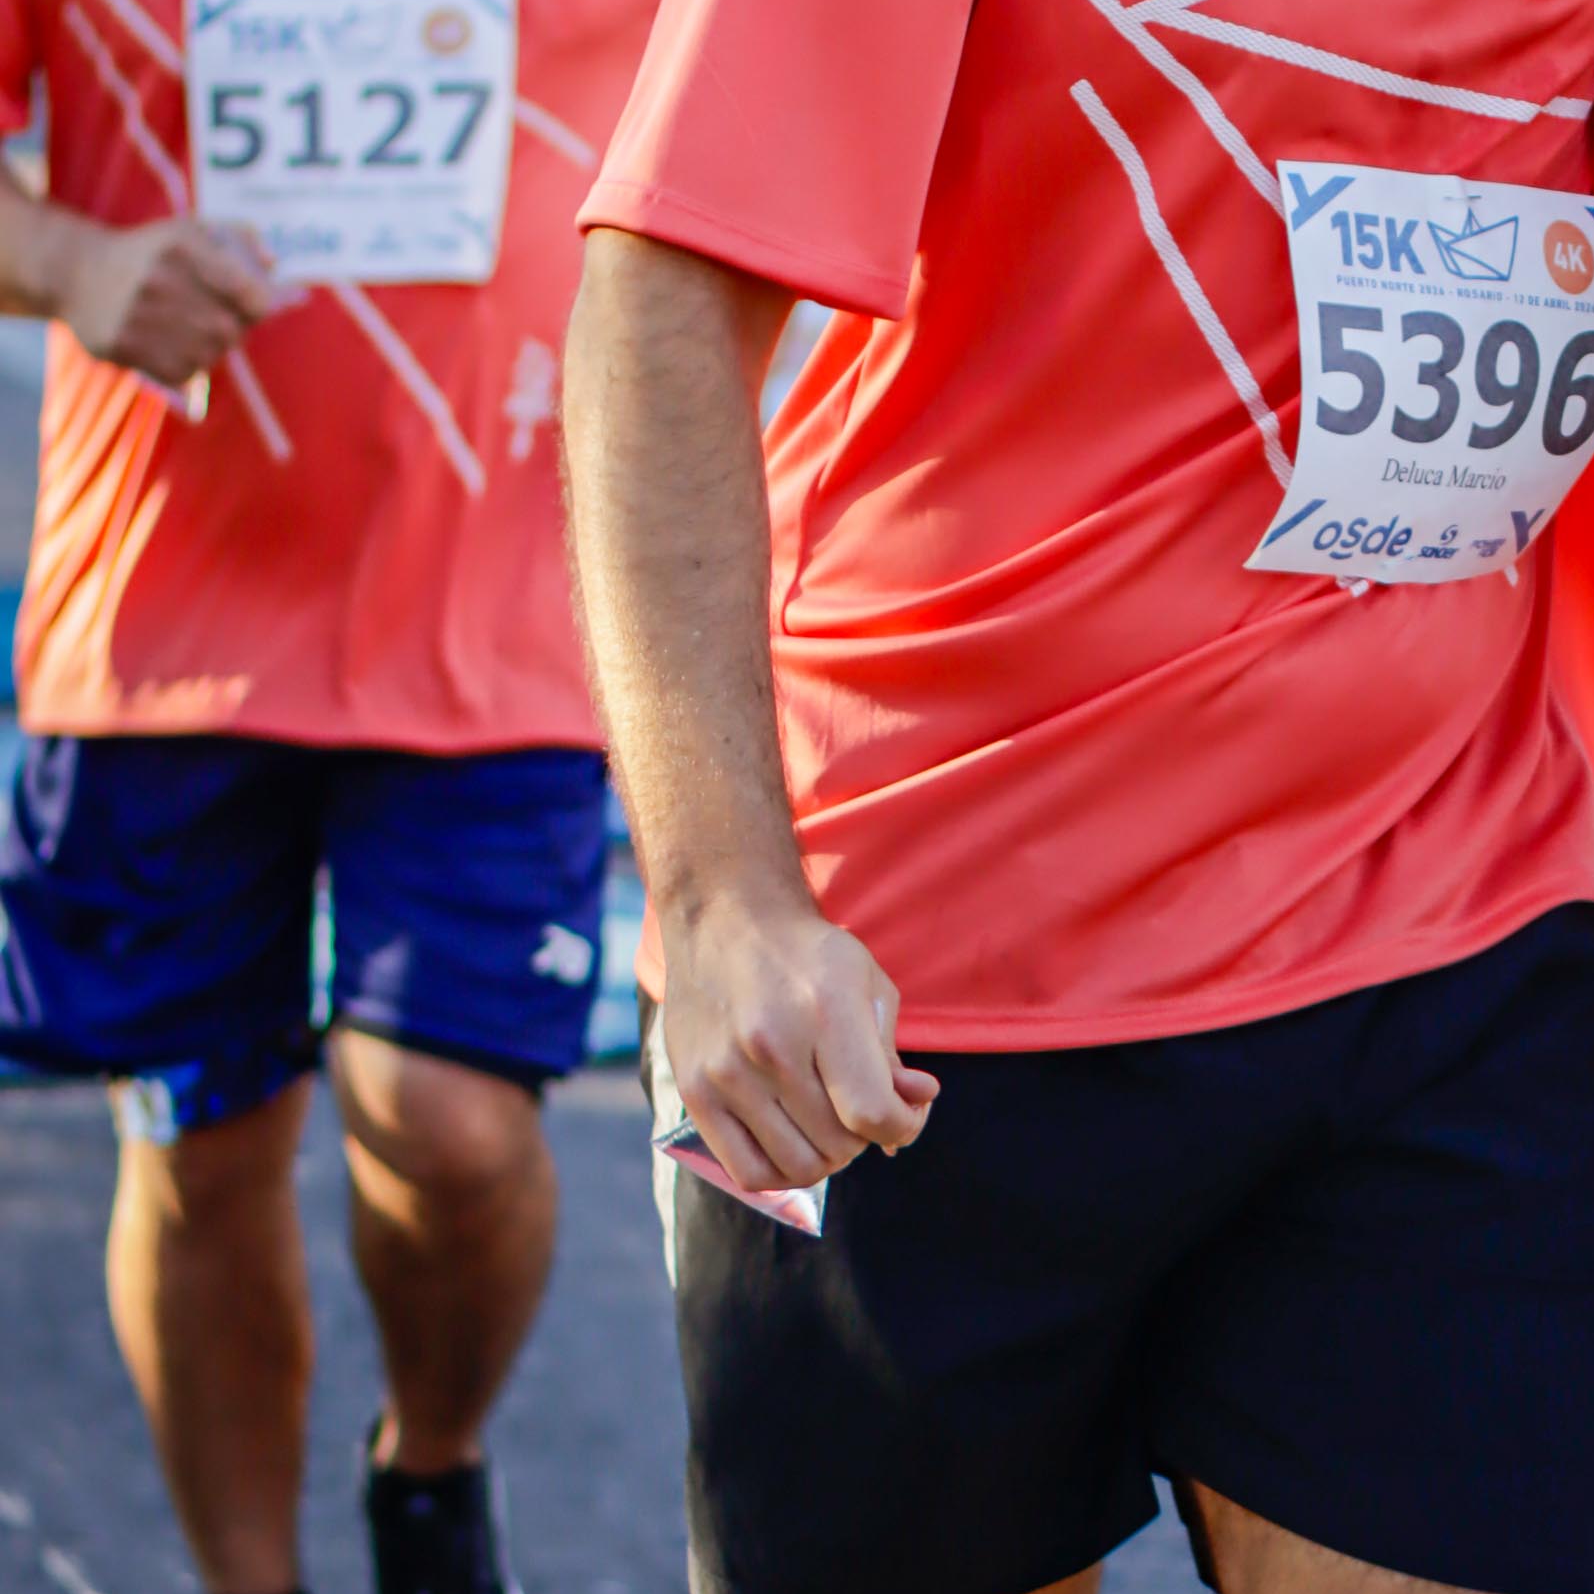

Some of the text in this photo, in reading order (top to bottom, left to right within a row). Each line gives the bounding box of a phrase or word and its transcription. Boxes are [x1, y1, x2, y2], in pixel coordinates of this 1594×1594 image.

[208, 81, 492, 169] 5127
[1330, 210, 1426, 275] 15K
[1554, 242, 1587, 274] 4K
[1336, 275, 1377, 289] PUERTO
[1381, 280, 1415, 294] NORTE
[1528, 295, 1540, 307] DE
[1544, 297, 1571, 311] ABRIL
[1381, 458, 1507, 490] Deluca Marcio
[1312, 514, 1413, 560] osde
